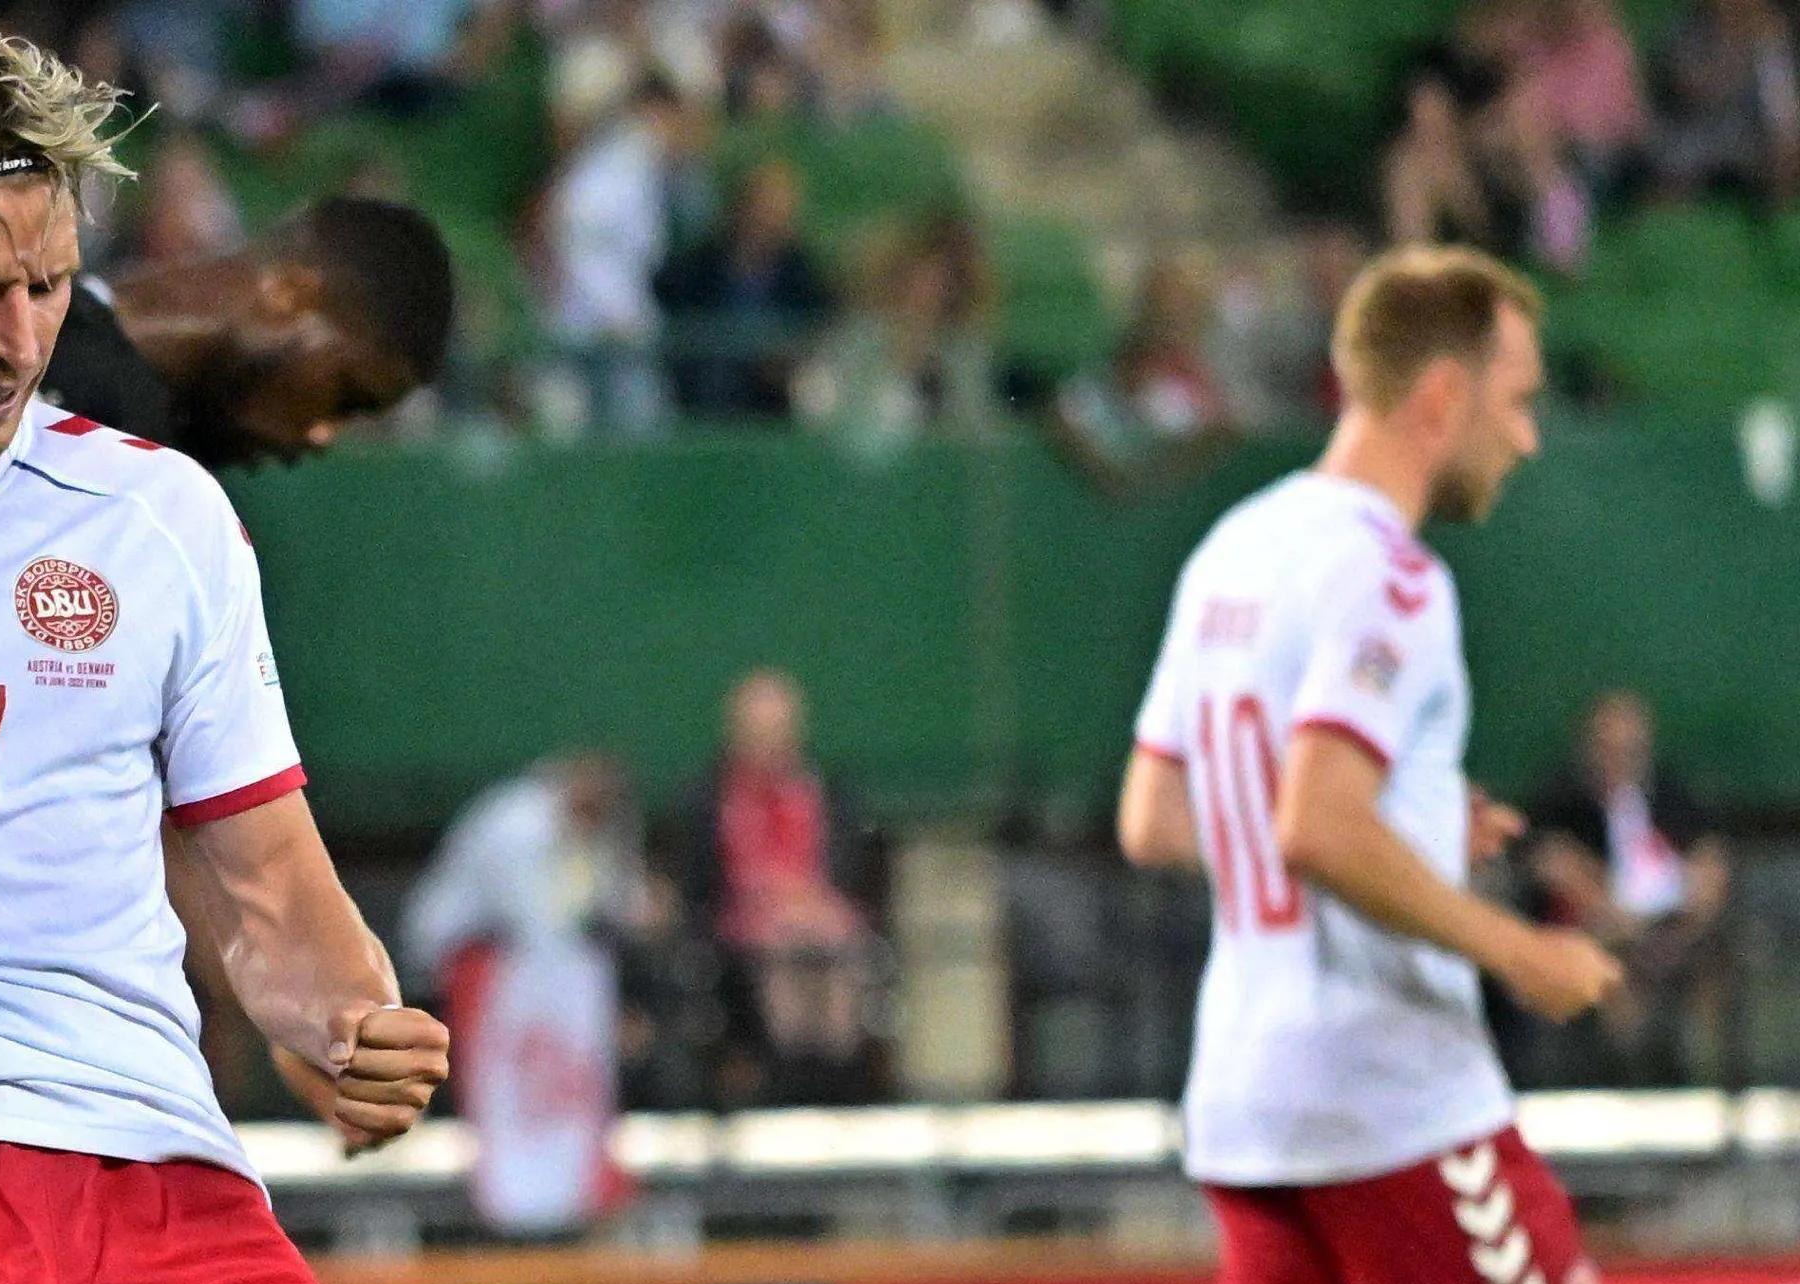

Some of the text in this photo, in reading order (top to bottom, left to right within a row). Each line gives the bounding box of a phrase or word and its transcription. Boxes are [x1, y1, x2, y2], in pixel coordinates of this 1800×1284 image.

[32, 588, 96, 618] DBU
[55, 636, 96, 651] 1889
[27, 659, 63, 673] AUSTRIA
[76, 662, 115, 676] DENMARK
[1198, 692, 1303, 935] 10
